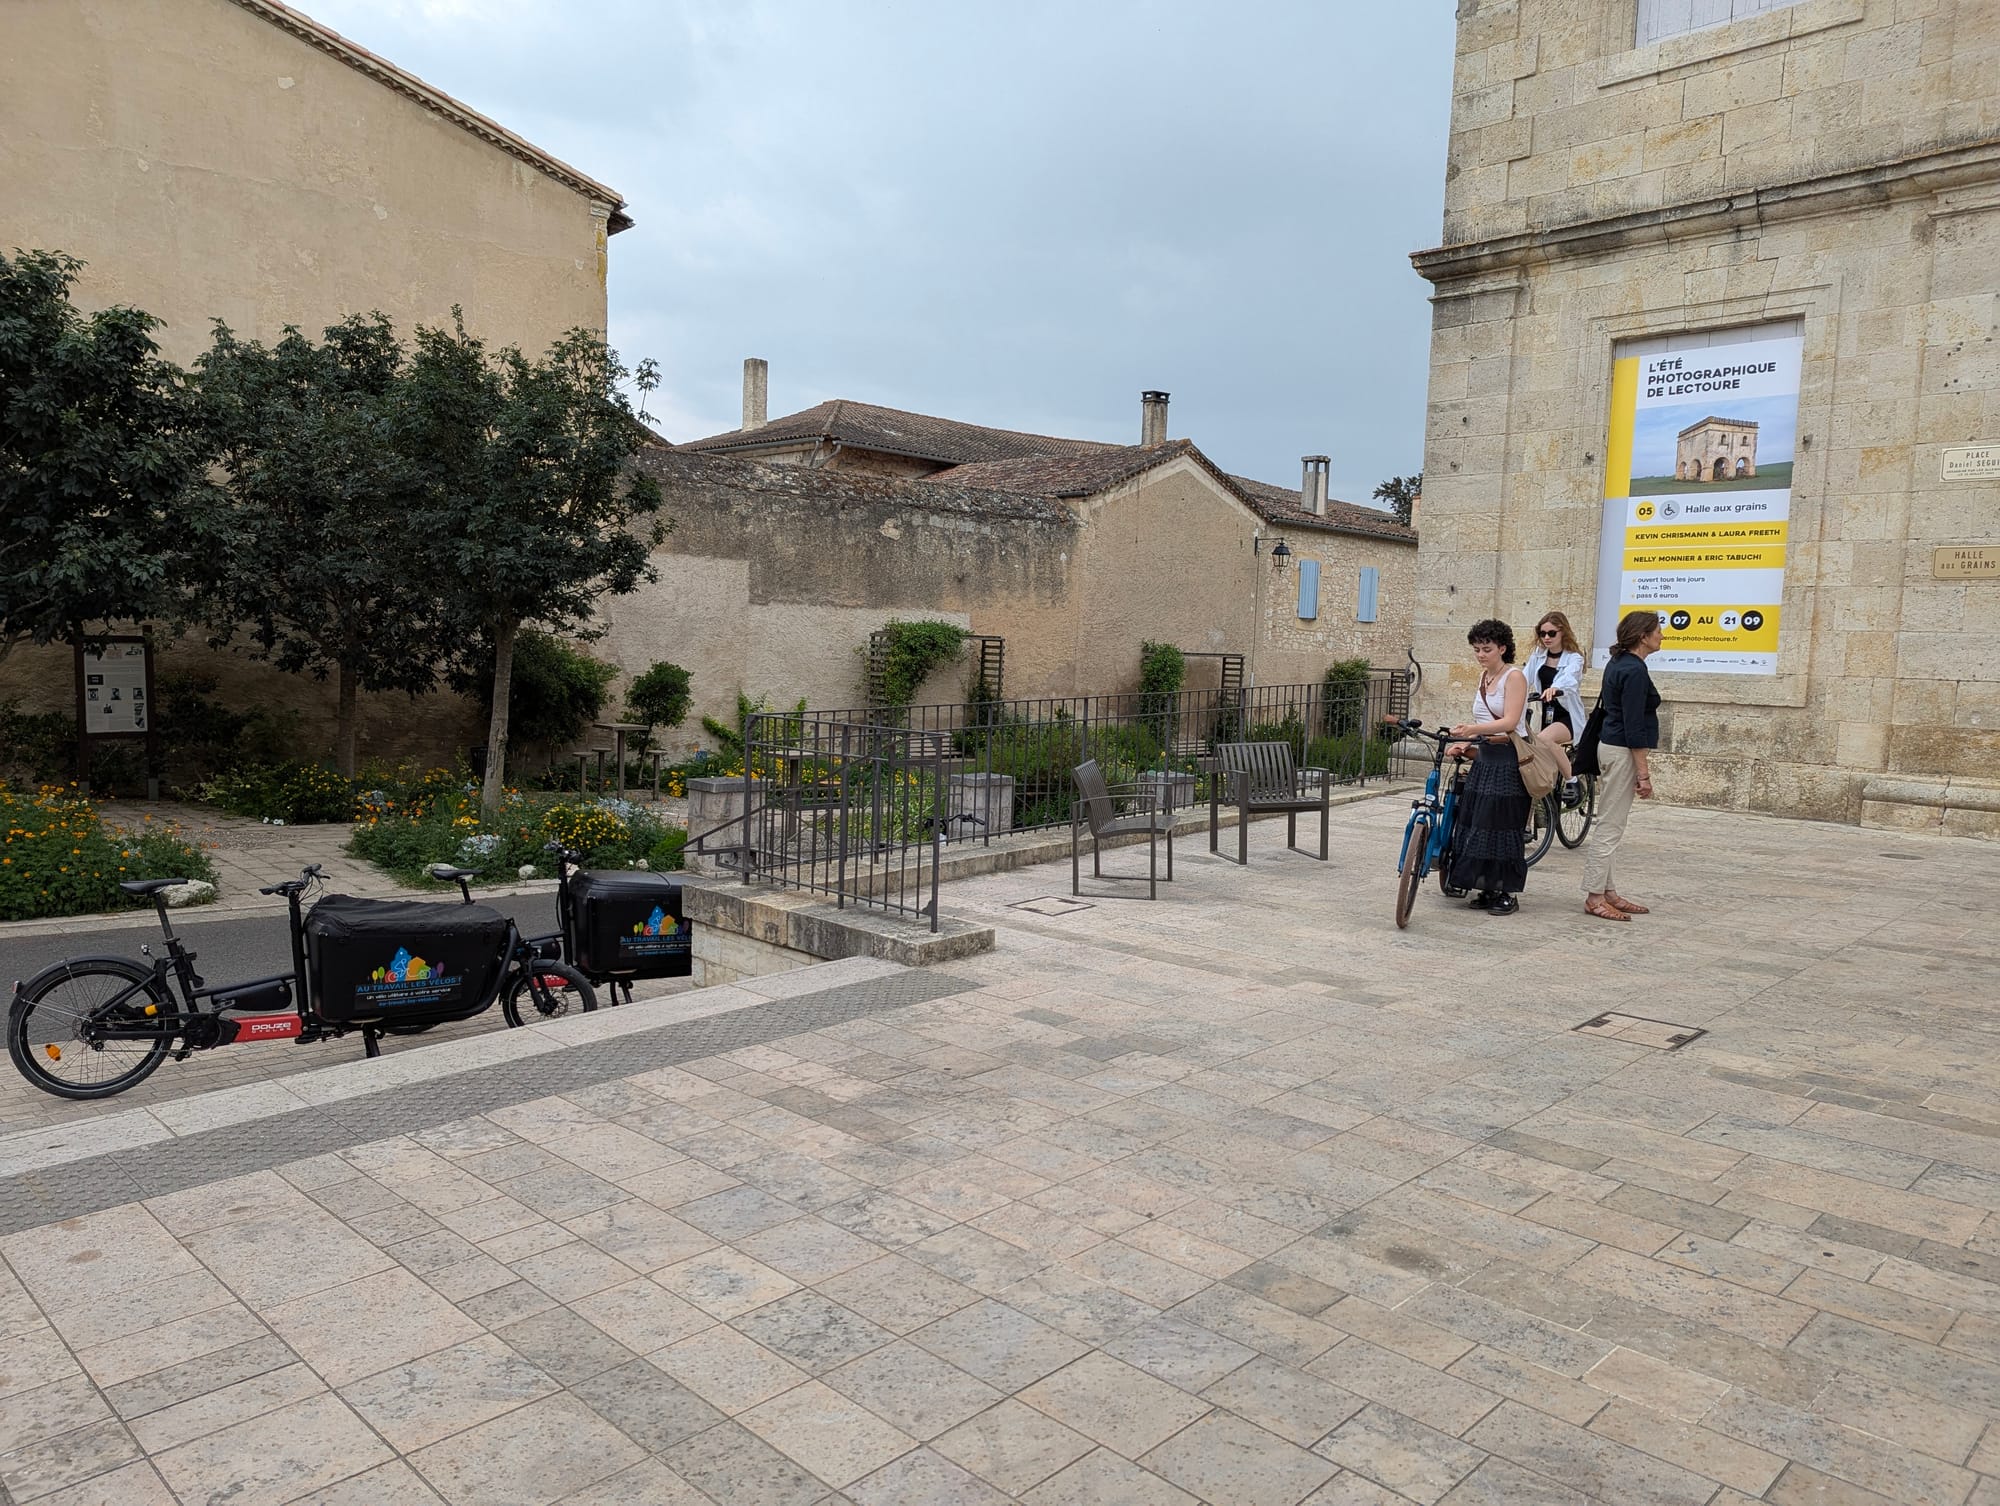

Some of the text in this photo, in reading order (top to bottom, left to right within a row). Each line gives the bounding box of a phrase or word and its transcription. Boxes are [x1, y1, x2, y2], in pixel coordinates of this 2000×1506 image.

[1649, 357, 1683, 373] L'ÉTÉ
[1647, 362, 1777, 385] PHOTOGRAPHIQUE
[1647, 379, 1741, 398] DE LECTOURE
[1966, 451, 1990, 459] PLACE
[1638, 502, 1768, 516] 05 Halle aux grains
[1660, 531, 1709, 539] CHRISMANN
[1954, 550, 1984, 559] HALLE
[1960, 560, 1996, 569] GRAINS
[1673, 616, 1688, 625] 07
[1697, 616, 1714, 625] AU
[1724, 616, 1736, 625] 21
[1744, 616, 1761, 625] 09
[1662, 634, 1738, 643] entre-photo-lectoure.fr
[373, 982, 408, 991] TRAVAIL
[411, 980, 426, 988] LES
[251, 1021, 291, 1030] DOUZE
